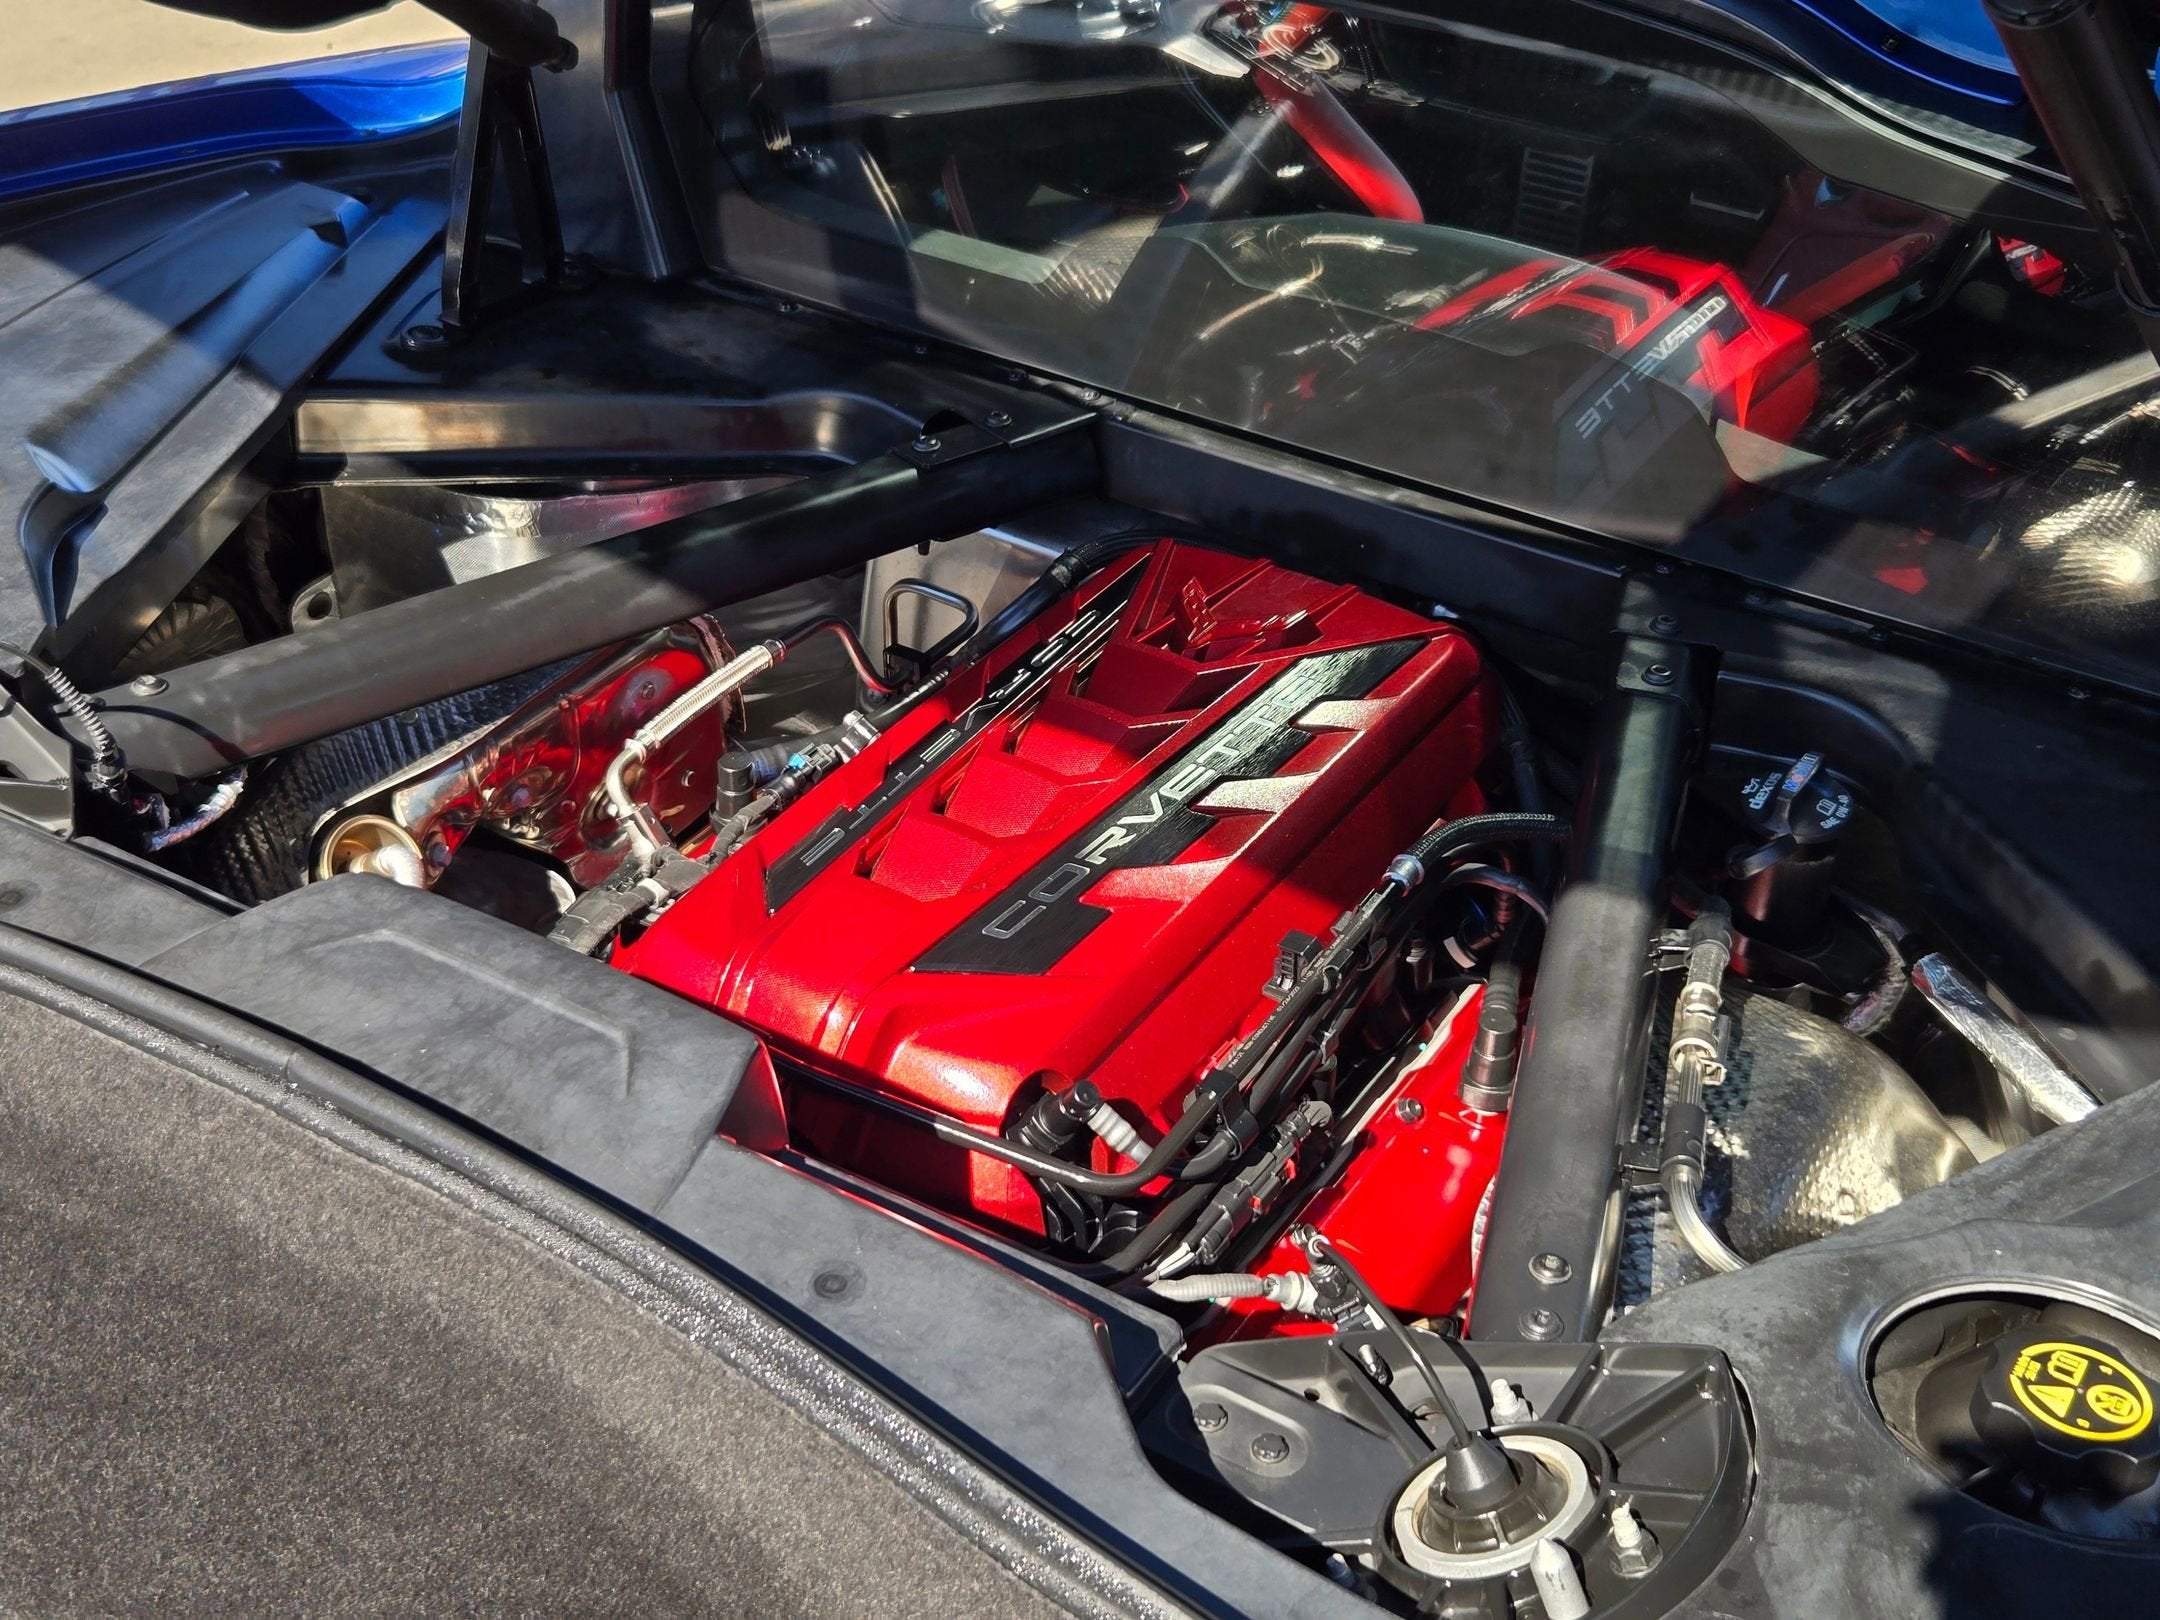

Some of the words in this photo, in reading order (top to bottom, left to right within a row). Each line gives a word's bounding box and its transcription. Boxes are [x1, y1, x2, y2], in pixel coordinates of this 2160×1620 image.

[799, 609, 1098, 866] CORVETTE
[981, 674, 1320, 939] CORVETTE
[1748, 772, 1782, 810] dexos
[1820, 816, 1840, 829] SAE
